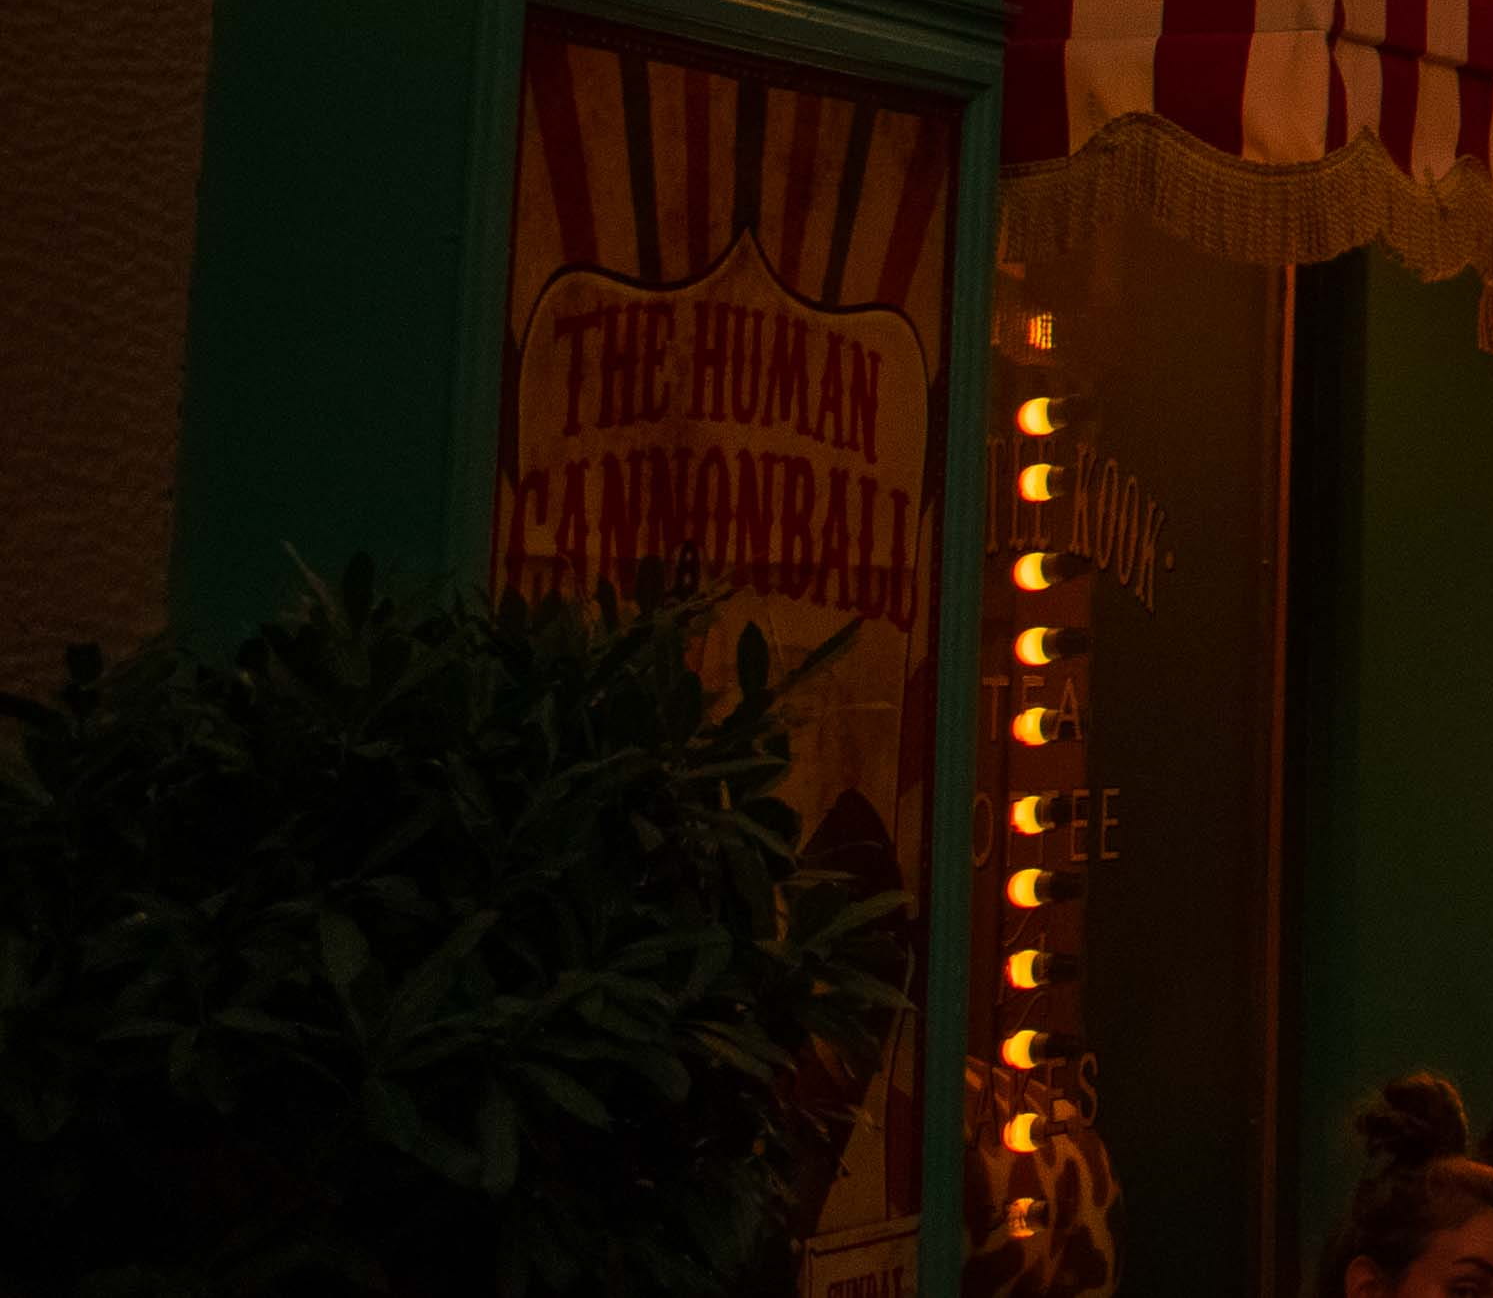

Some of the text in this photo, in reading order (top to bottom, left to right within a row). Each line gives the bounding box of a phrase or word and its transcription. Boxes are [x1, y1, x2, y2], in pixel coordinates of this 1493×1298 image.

[555, 300, 881, 463] THE HUMAN
[507, 448, 918, 633] CANNONBALL
